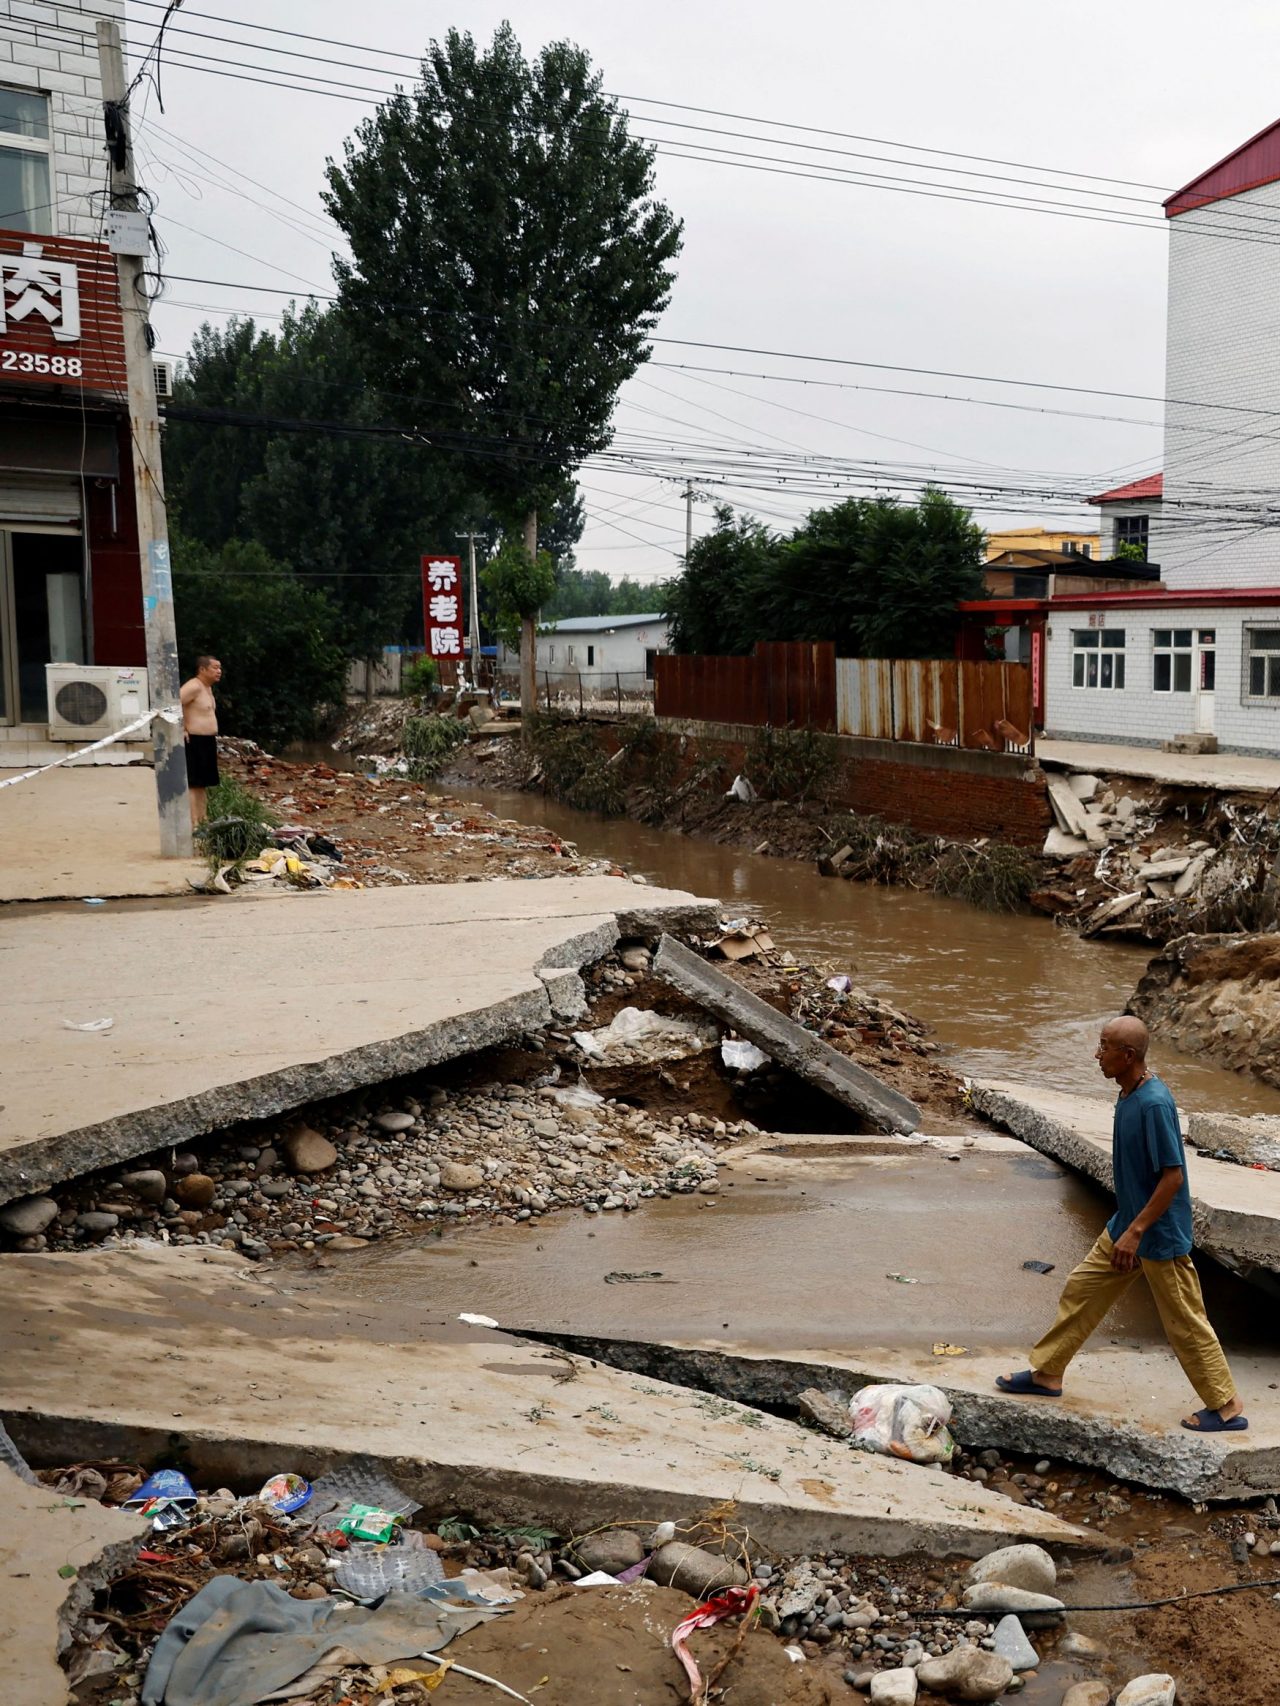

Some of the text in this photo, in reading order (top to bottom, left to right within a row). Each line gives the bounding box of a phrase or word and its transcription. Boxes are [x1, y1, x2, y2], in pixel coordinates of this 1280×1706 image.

[0, 242, 81, 342] 肉
[1, 350, 83, 377] 23588
[428, 560, 461, 655] 养老院
